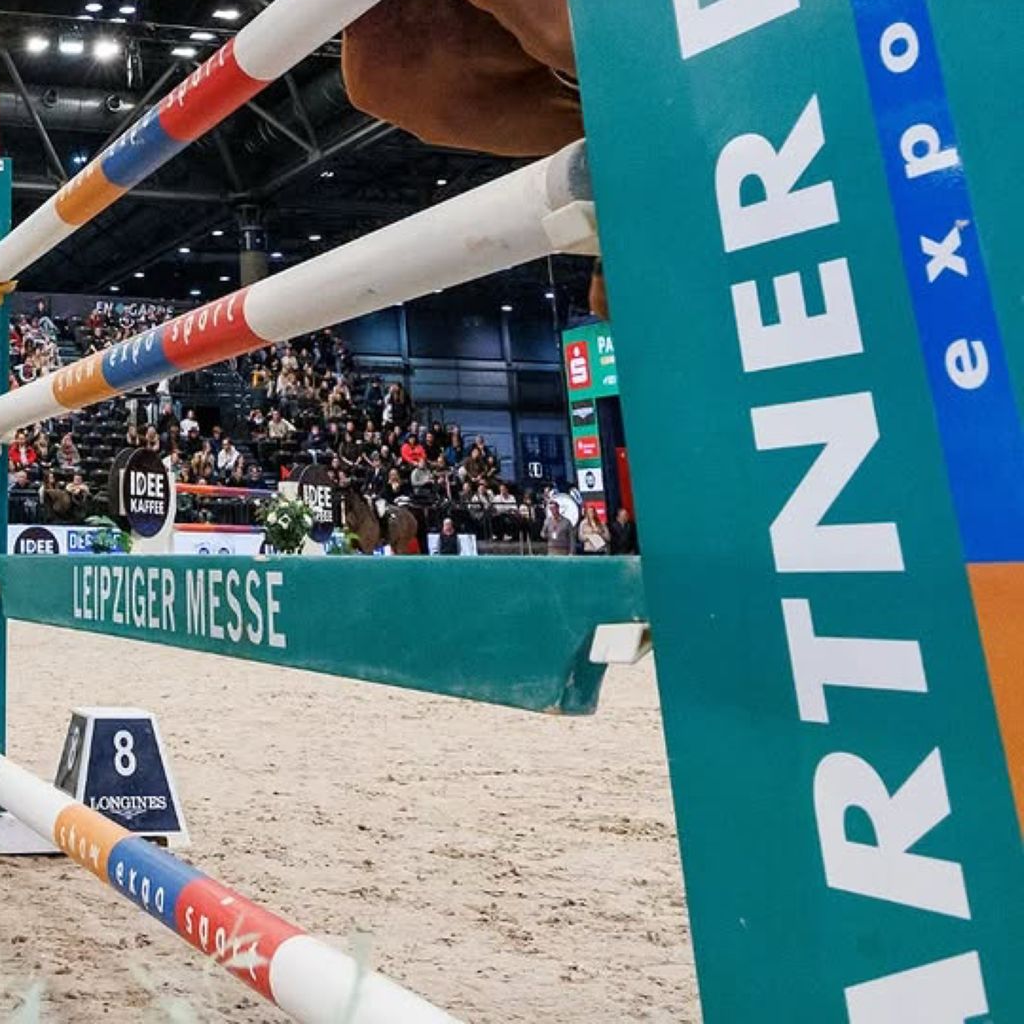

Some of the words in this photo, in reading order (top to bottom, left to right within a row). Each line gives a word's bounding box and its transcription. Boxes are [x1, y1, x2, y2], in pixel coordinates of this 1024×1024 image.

[878, 21, 991, 391] expo
[171, 294, 237, 345] sport
[130, 471, 164, 498] IDEE
[303, 484, 333, 508] IDEE
[130, 500, 164, 515] KAFFEE
[20, 540, 54, 554] IDEE
[73, 565, 176, 632] LEIPZIGER
[185, 568, 288, 649] MESSE
[113, 730, 137, 777] 8
[90, 795, 167, 811] LONGINES
[115, 861, 164, 913] expo
